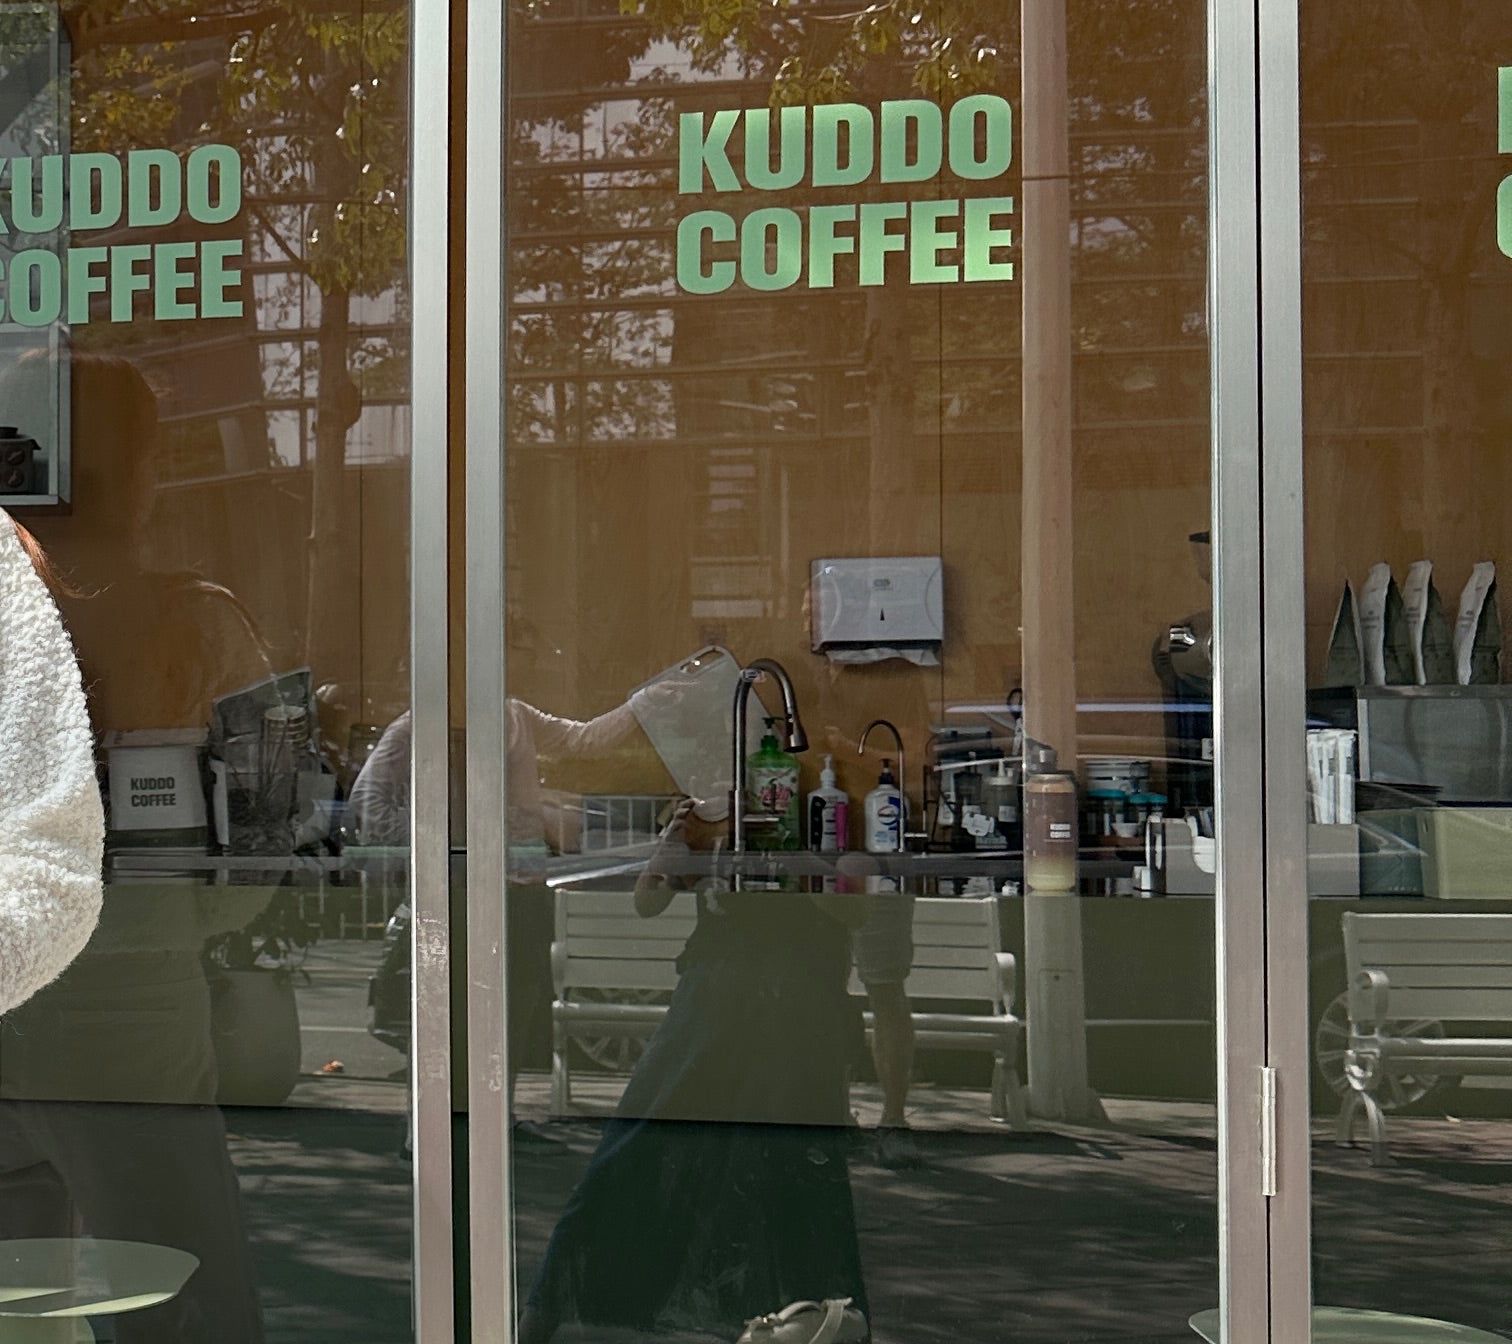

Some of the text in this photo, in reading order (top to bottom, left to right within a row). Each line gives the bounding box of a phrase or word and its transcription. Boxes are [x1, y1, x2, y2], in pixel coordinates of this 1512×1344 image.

[678, 93, 1013, 195] KUDDO
[676, 196, 1014, 295] COFFEE
[130, 777, 175, 791] KUDDO
[131, 793, 176, 807] COFFEE
